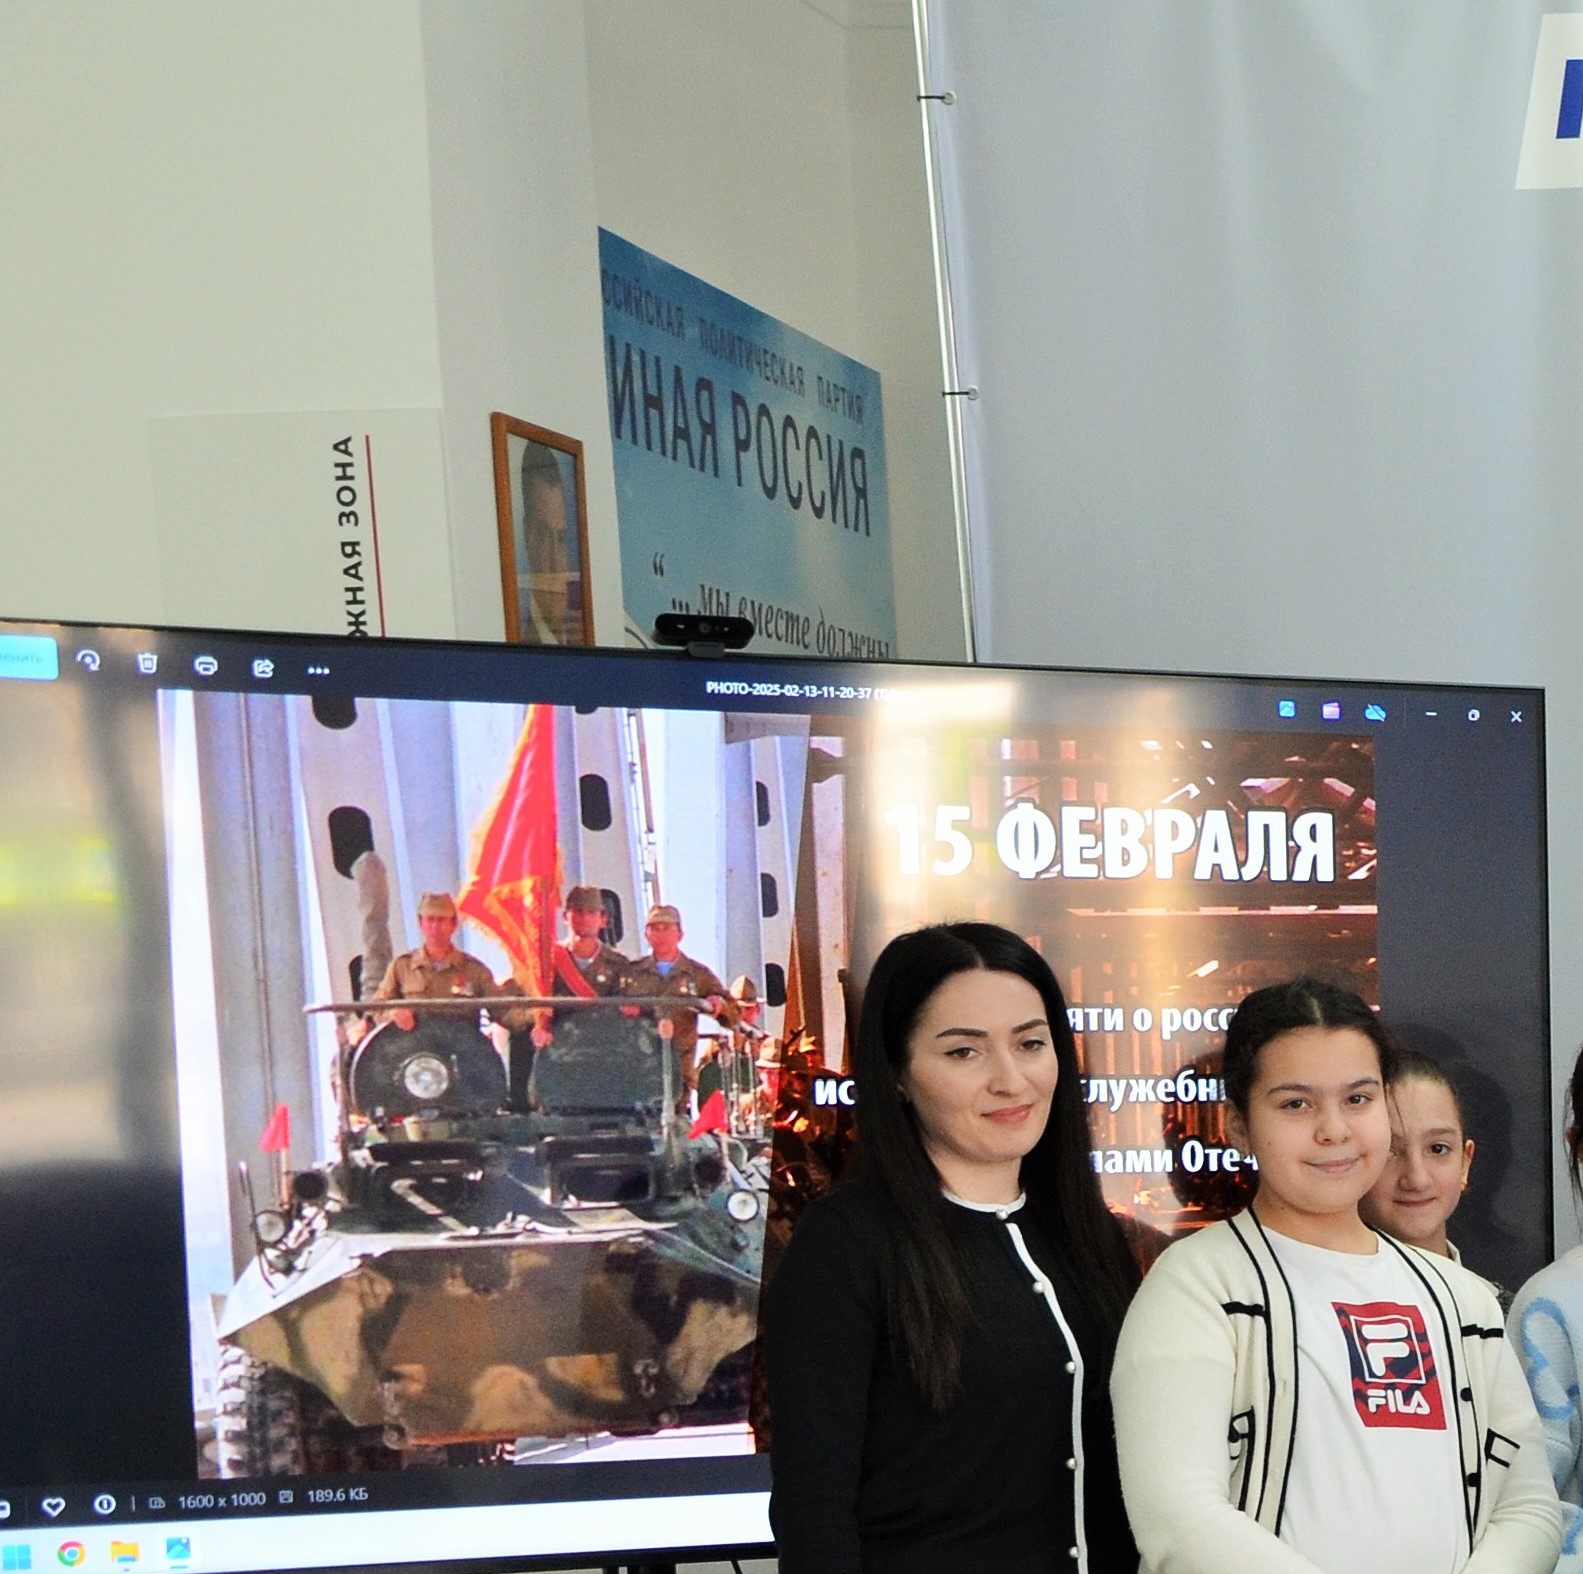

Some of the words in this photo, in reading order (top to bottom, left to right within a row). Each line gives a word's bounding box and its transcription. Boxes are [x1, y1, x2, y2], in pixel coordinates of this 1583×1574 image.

[816, 374, 864, 425] ПАРТИЯ
[608, 334, 719, 478] ИНАЯ
[730, 390, 870, 537] РОССИЯ
[332, 436, 359, 527] ЗОНА
[706, 681, 871, 699] PHOTO-2025-02-13-11-20-37
[885, 803, 974, 876] 15
[996, 801, 1335, 882] ФЕВРАЛЯ
[1066, 1007, 1124, 1032] яти
[1132, 1007, 1153, 1032] о
[1161, 1007, 1238, 1040] росс
[1080, 1069, 1227, 1112] лужебн
[1181, 1140, 1259, 1173] Отеч
[1367, 1388, 1431, 1414] FILA
[179, 1495, 214, 1509] 1600
[231, 1492, 266, 1506] 1000
[308, 1488, 346, 1502] 189.6
[349, 1486, 369, 1500] КБ
